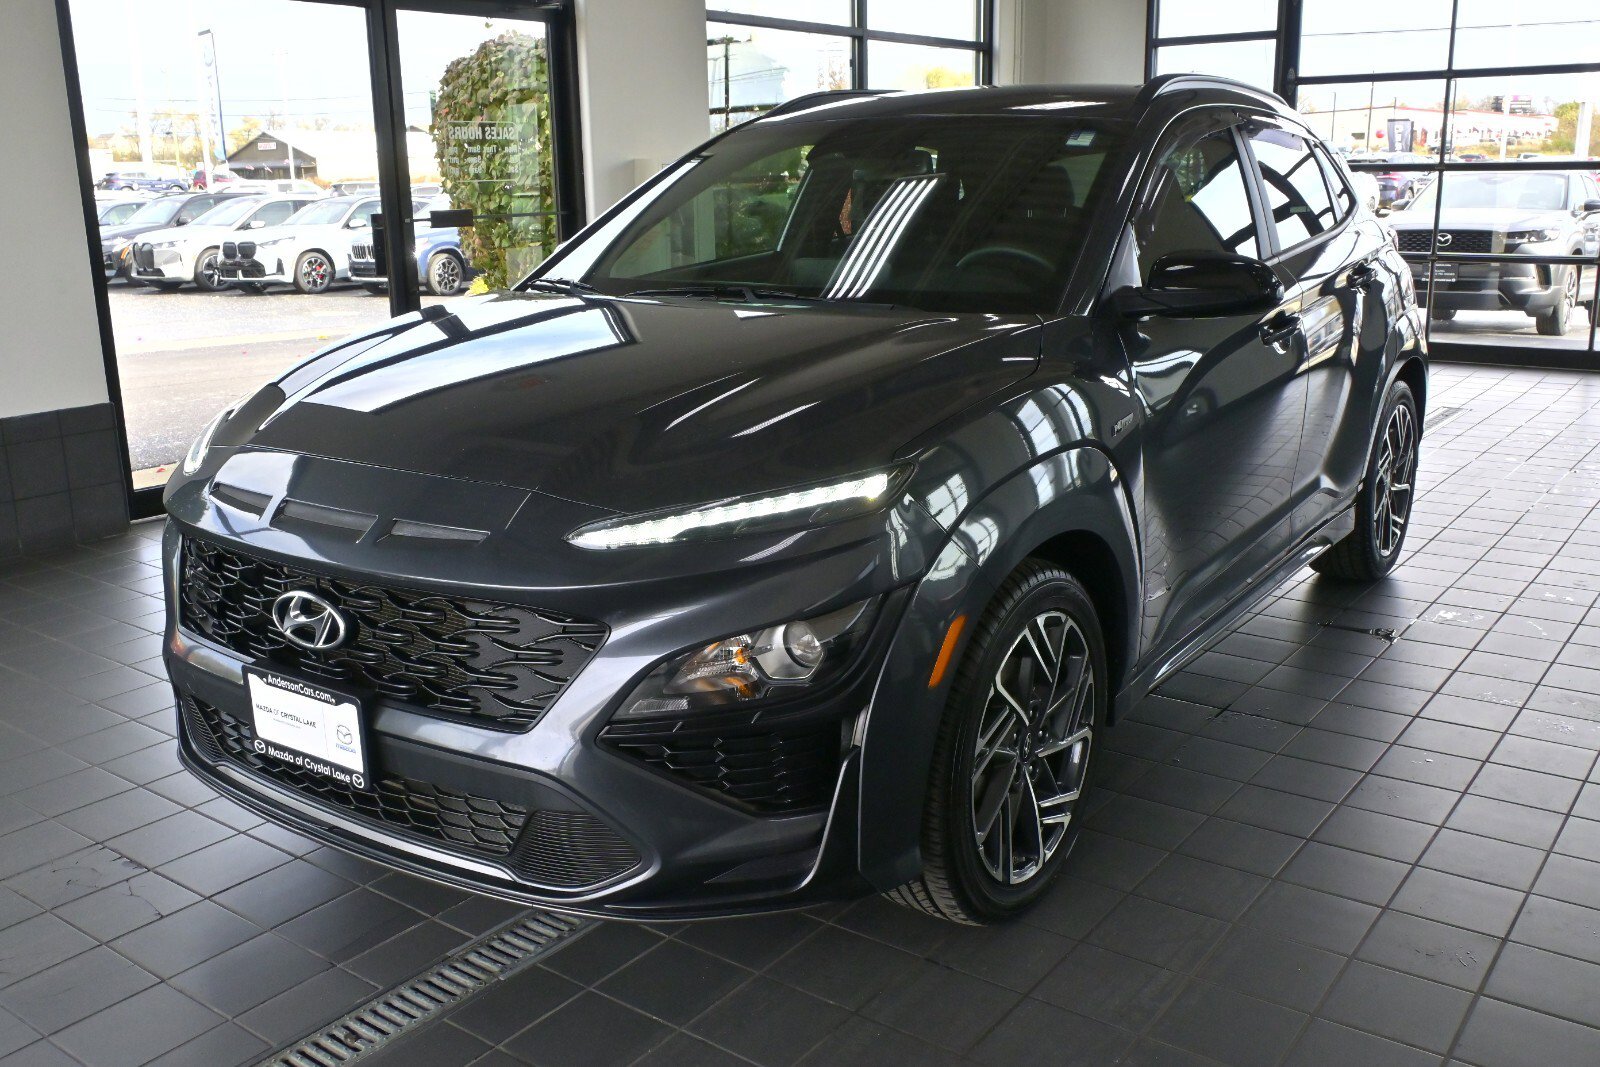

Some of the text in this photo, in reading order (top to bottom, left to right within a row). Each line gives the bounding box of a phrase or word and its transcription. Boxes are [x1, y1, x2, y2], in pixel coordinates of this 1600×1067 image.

[267, 674, 332, 703] AndersonCars.com
[255, 703, 273, 714] MAZDA
[273, 707, 280, 716] OF
[280, 711, 302, 724] CRYSTAL
[302, 717, 317, 729] LAKE
[268, 746, 351, 783] Mazda of Crystal Lake
